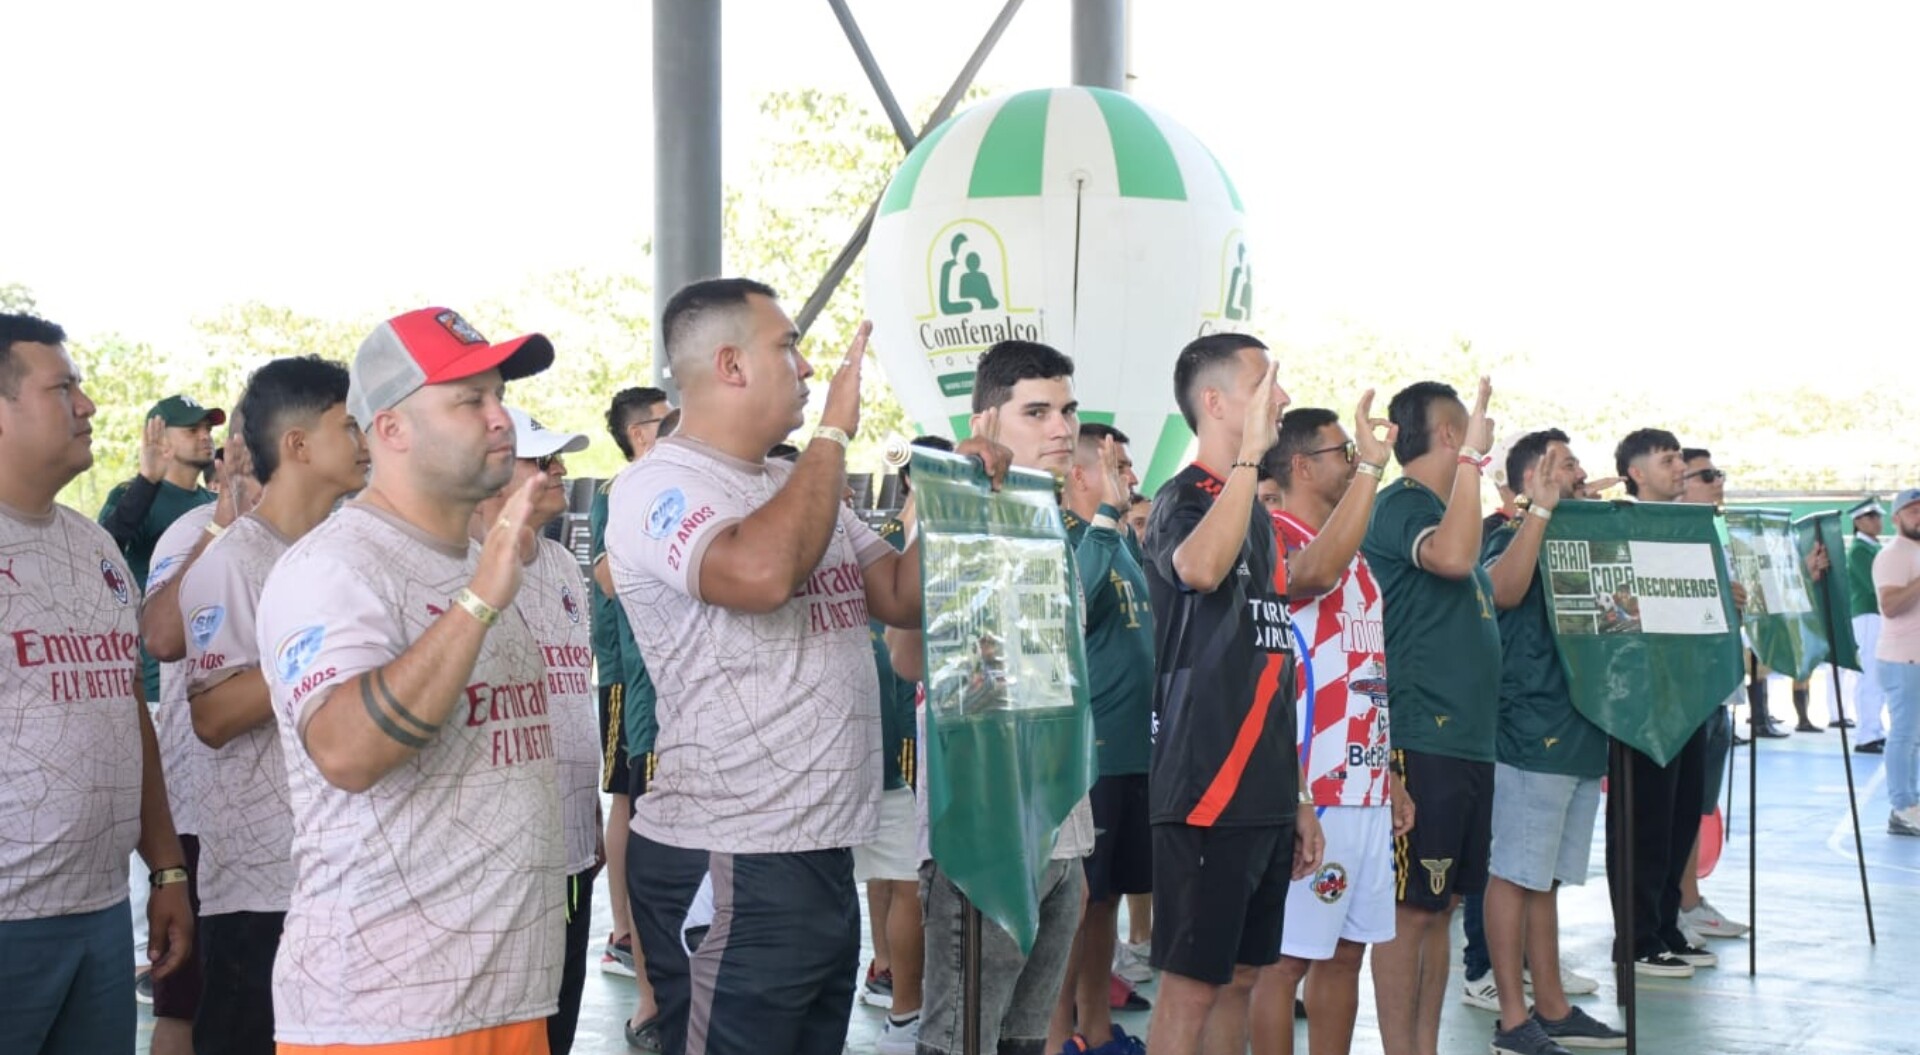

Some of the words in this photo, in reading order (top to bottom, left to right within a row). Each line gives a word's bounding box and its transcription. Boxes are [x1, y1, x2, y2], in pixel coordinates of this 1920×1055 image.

[920, 316, 1038, 350] Comfenalco
[667, 543, 682, 571] 27
[676, 505, 716, 545] AÑOS
[1550, 542, 1589, 570] GRAN
[1591, 565, 1637, 596] COPA
[1636, 577, 1719, 598] RECOCHEROS
[51, 669, 81, 702] FLY
[492, 727, 520, 767] FLY
